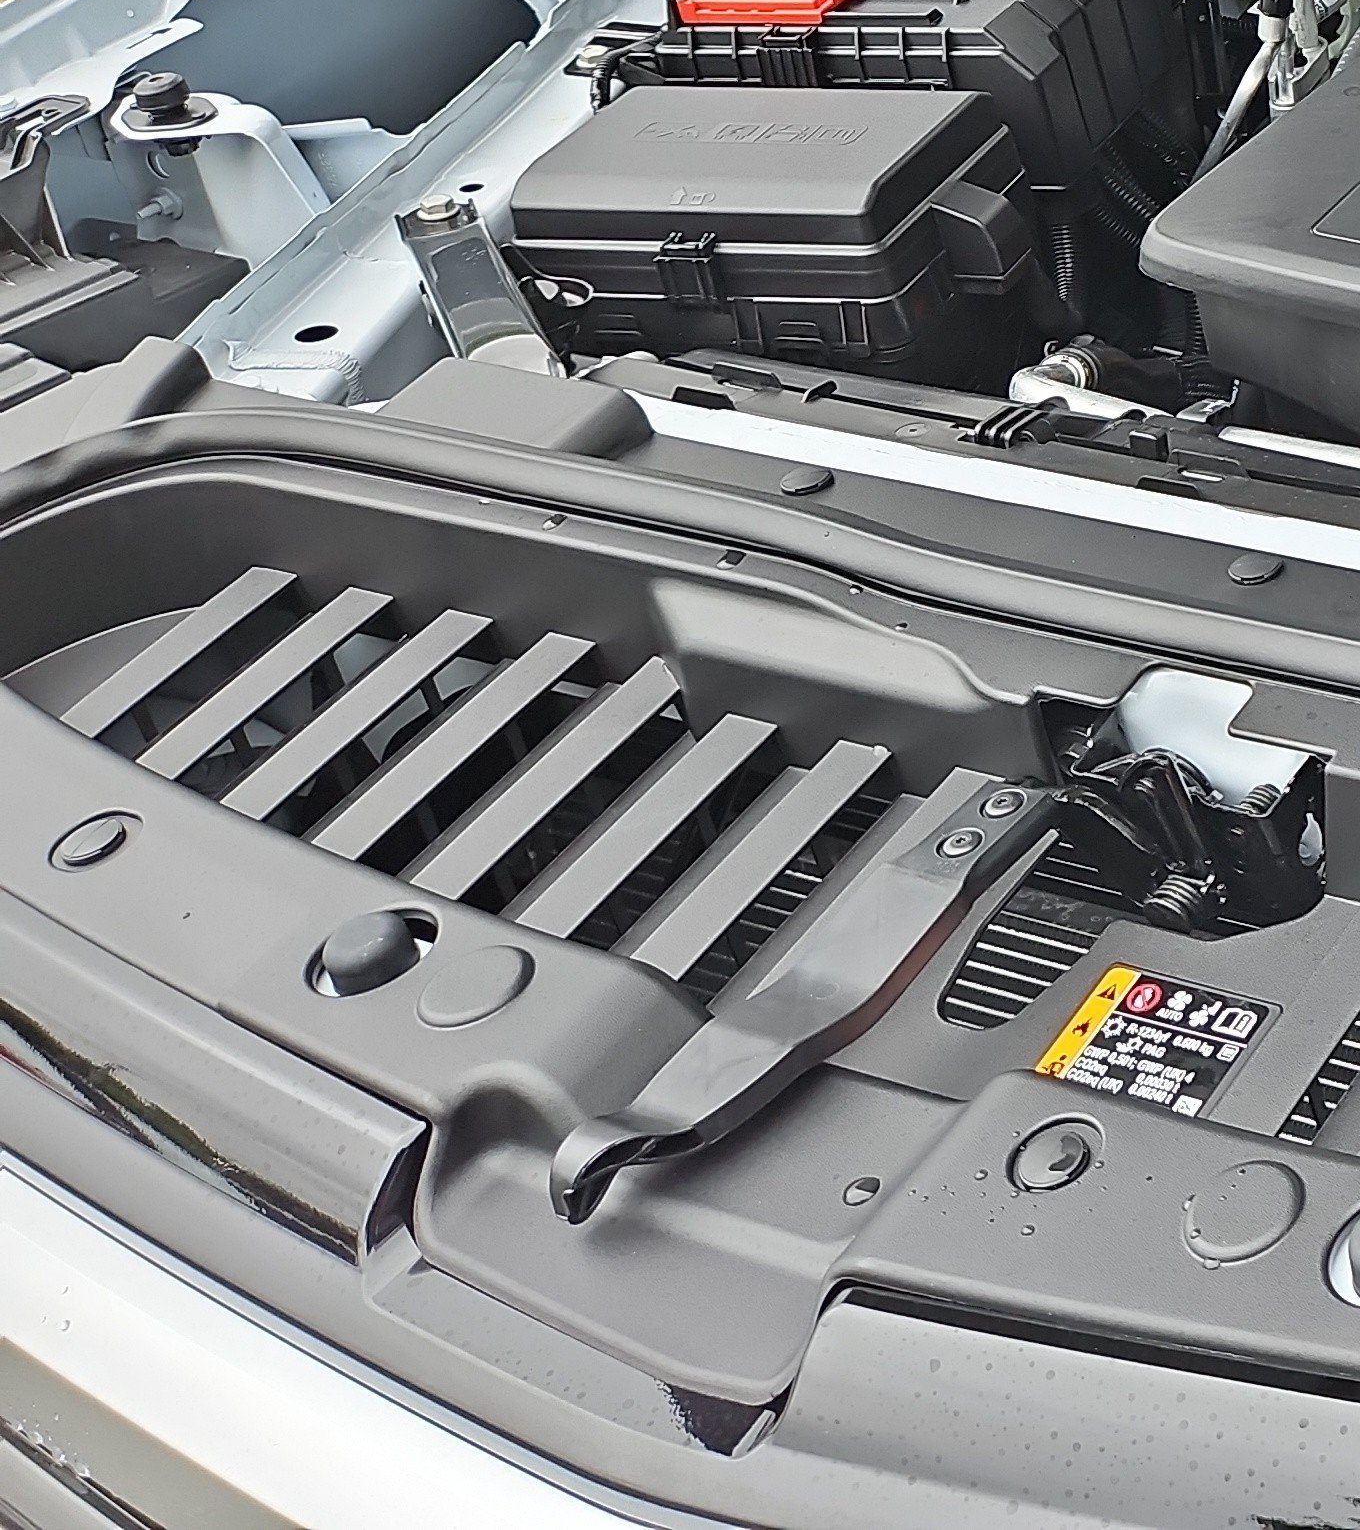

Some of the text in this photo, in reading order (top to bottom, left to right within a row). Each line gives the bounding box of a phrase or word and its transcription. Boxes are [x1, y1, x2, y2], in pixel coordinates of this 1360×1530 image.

[1156, 1008, 1183, 1022] AUTO
[1126, 1023, 1215, 1057] R-1234yf 0.600 kg
[1141, 1043, 1166, 1058] PAG
[1075, 1056, 1109, 1077] CO2eq
[1083, 1045, 1110, 1060] GWP
[1137, 1059, 1164, 1074] GWP
[1160, 1066, 1187, 1083] (UK)
[1066, 1067, 1100, 1089] CO2eq
[1097, 1076, 1124, 1094] (UK)
